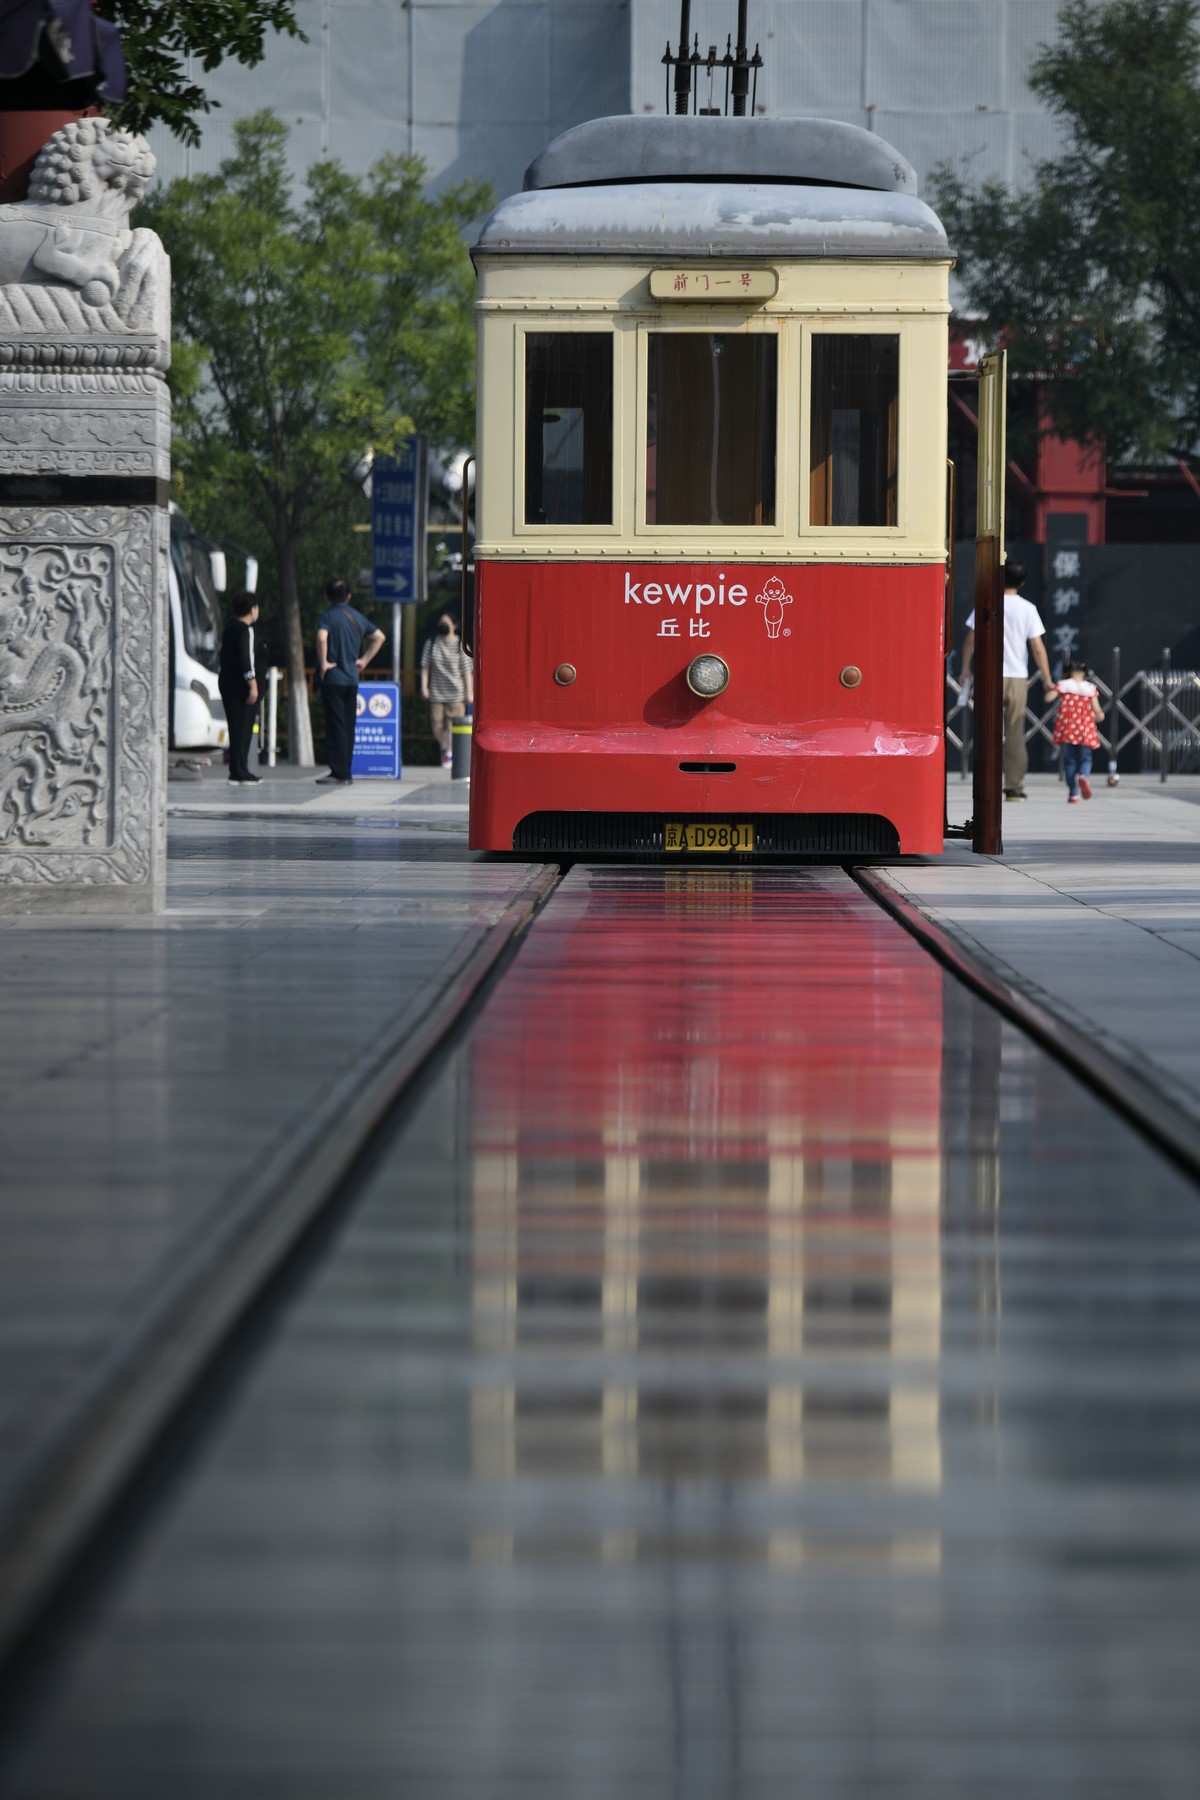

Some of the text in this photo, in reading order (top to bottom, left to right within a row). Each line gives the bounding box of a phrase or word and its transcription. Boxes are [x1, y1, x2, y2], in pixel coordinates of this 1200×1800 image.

[673, 273, 752, 292] 前门一号
[624, 571, 748, 614] kewpie
[656, 618, 711, 638] 丘比
